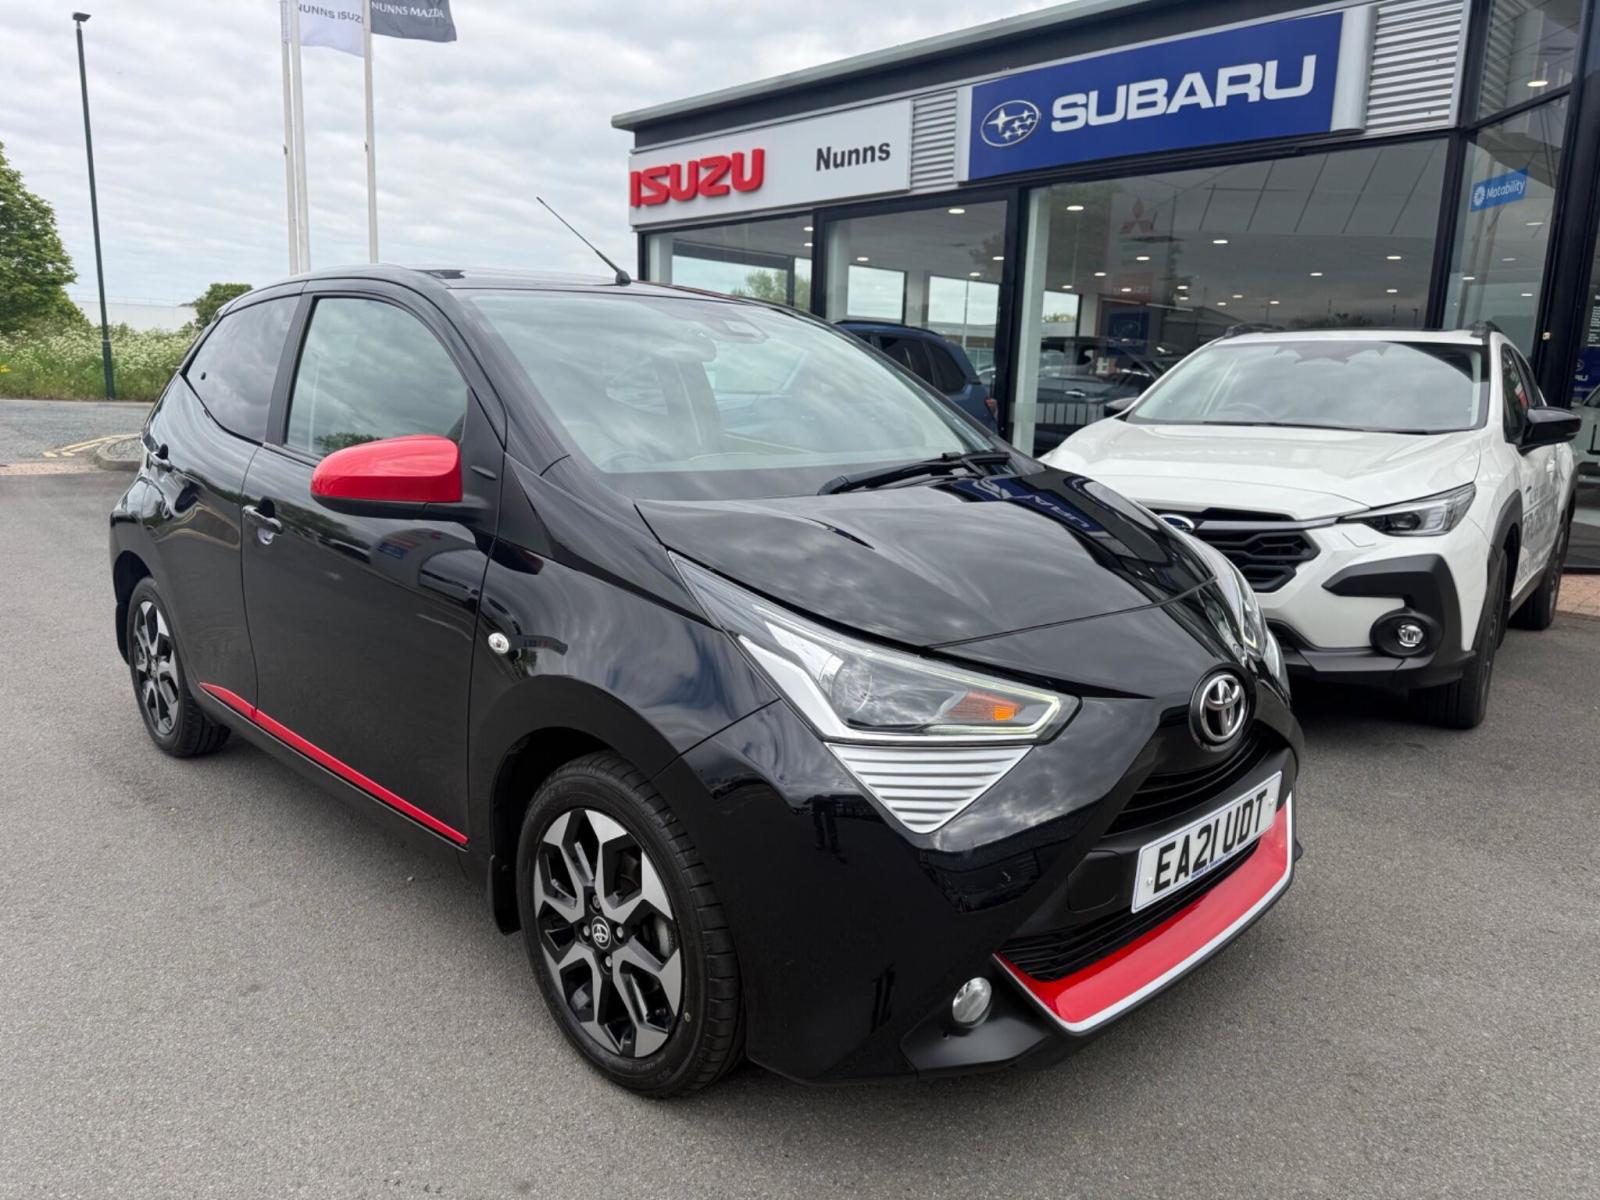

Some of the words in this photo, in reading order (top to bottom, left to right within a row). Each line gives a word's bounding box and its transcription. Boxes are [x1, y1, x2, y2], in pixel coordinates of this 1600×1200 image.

[337, 11, 364, 24] ISUZ
[371, 1, 408, 16] NUNNS
[410, 7, 445, 18] MAZDA
[1051, 54, 1317, 133] SUBARU
[816, 142, 891, 172] Nunns
[630, 148, 765, 208] ISUZU
[1486, 178, 1526, 199] Motability
[1153, 818, 1220, 894] EA21
[1222, 788, 1268, 854] UDT
